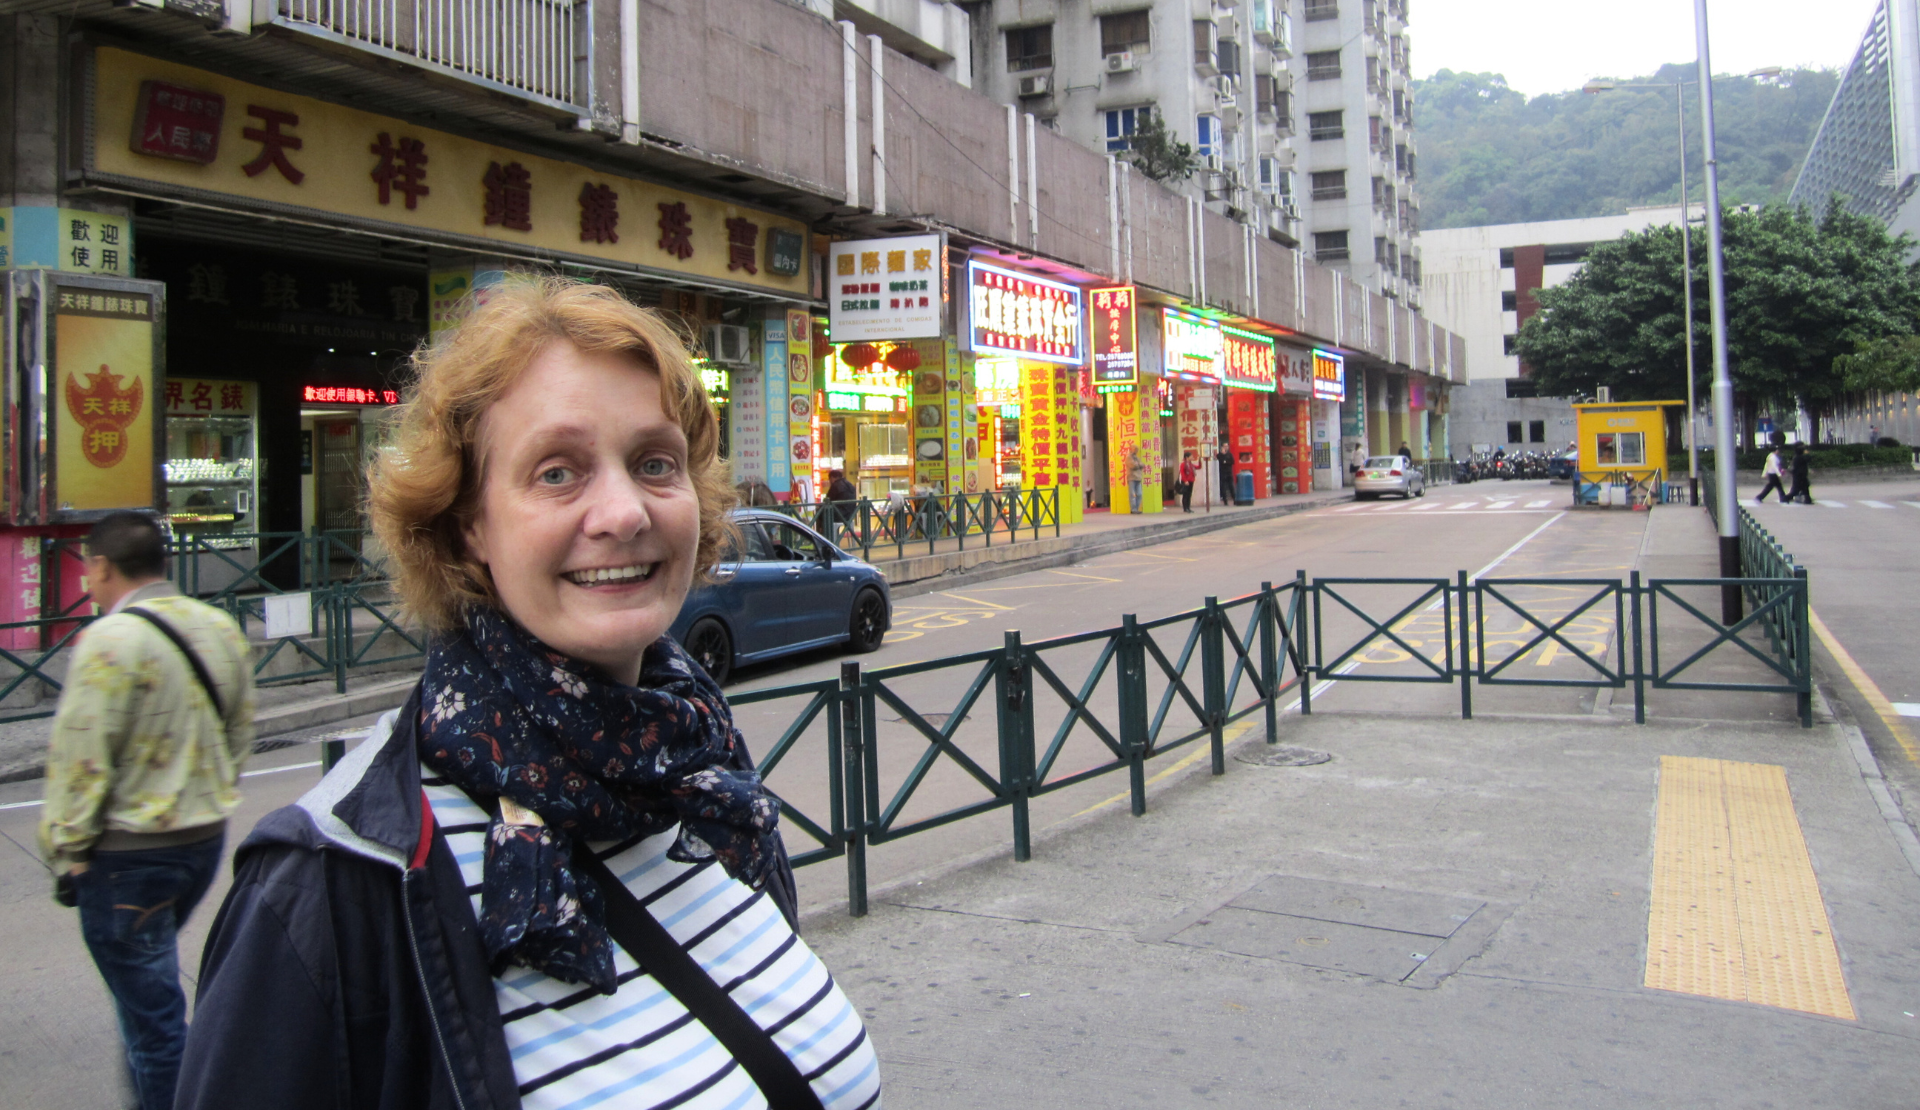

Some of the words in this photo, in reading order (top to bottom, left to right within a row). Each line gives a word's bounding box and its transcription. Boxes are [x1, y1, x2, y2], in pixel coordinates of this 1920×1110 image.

[71, 219, 119, 245] 歡迎
[71, 246, 119, 271] 使用
[83, 398, 132, 416] 天祥
[769, 347, 786, 478] 人民幣信用卡通用
[89, 429, 119, 454] 押
[1390, 614, 1616, 636] BUS
[1352, 639, 1608, 667] STOP
